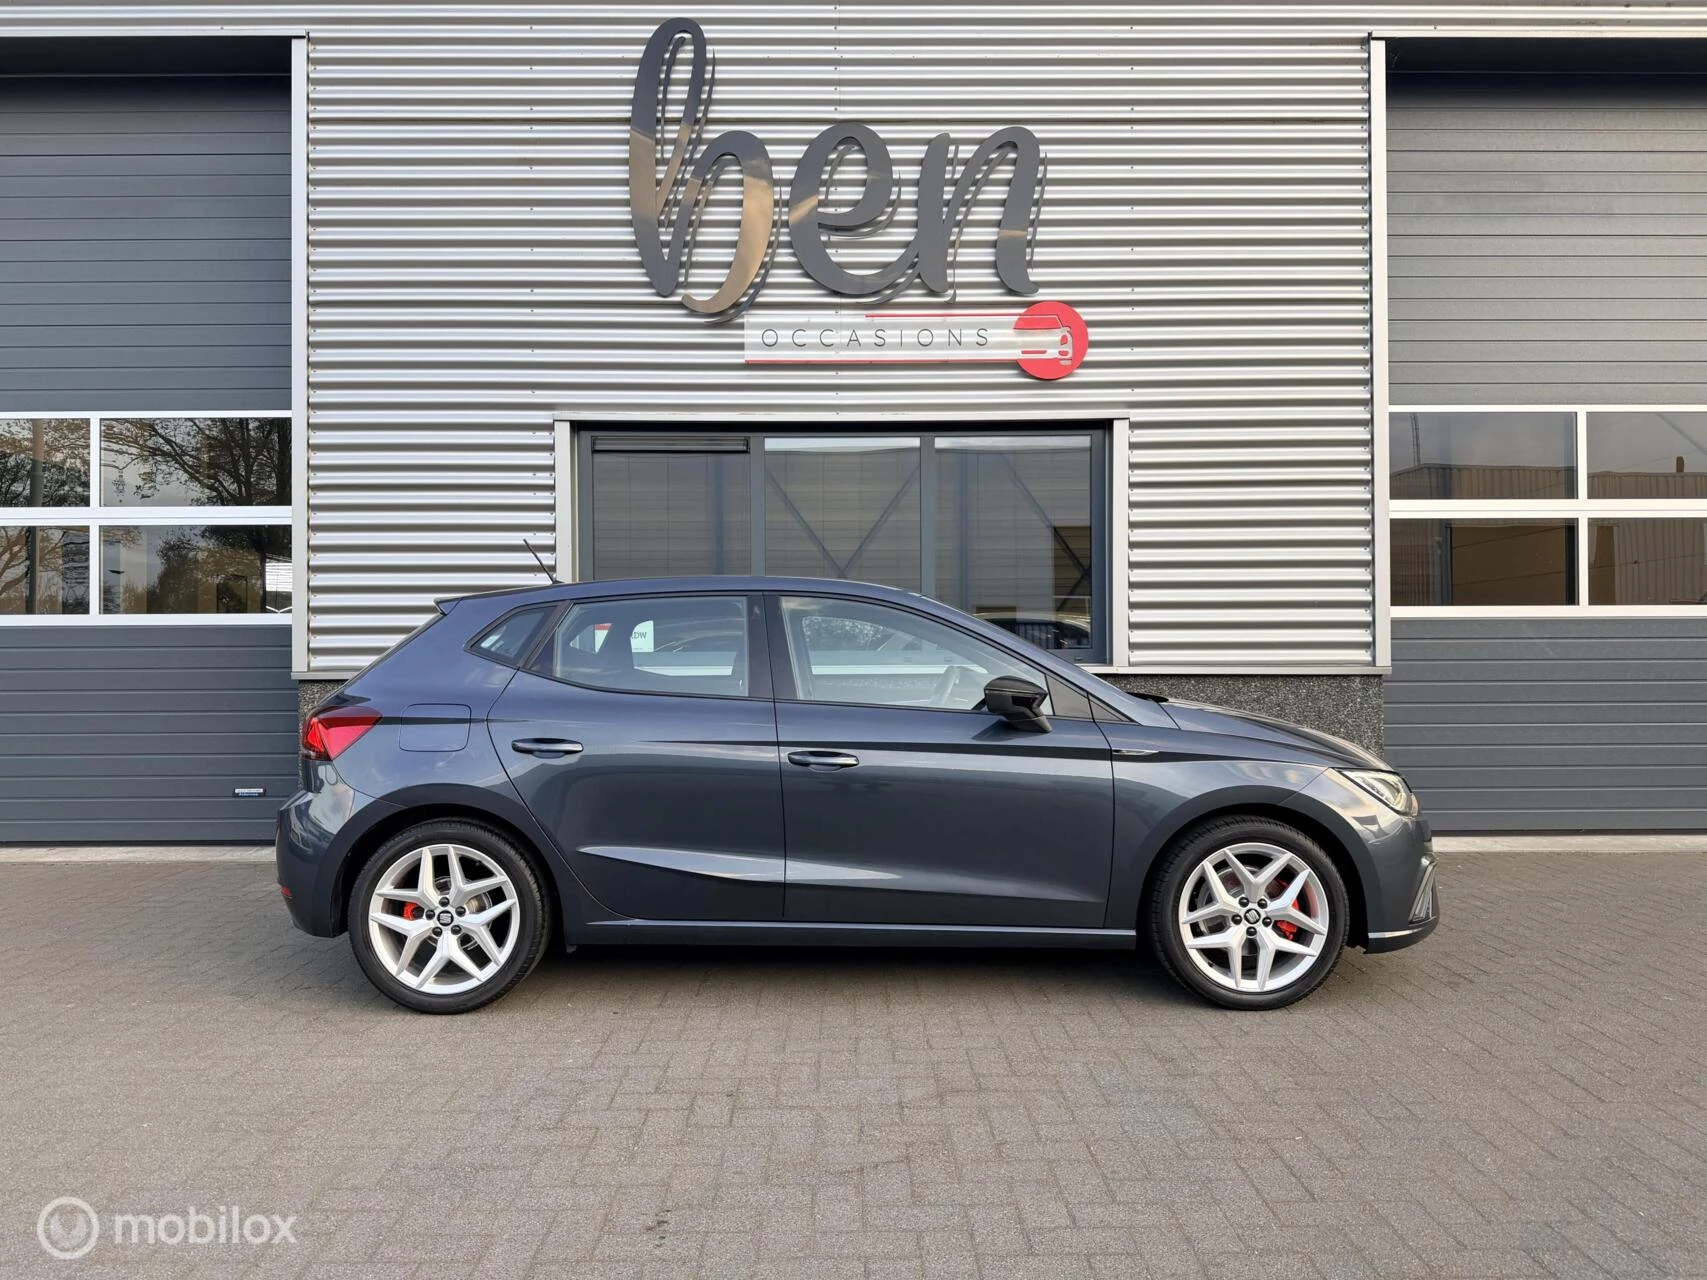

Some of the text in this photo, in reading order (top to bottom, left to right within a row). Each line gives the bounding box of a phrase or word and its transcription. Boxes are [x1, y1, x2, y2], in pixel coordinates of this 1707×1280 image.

[628, 17, 1041, 314] ben
[761, 328, 990, 348] OCCASIONS
[631, 631, 647, 640] DW
